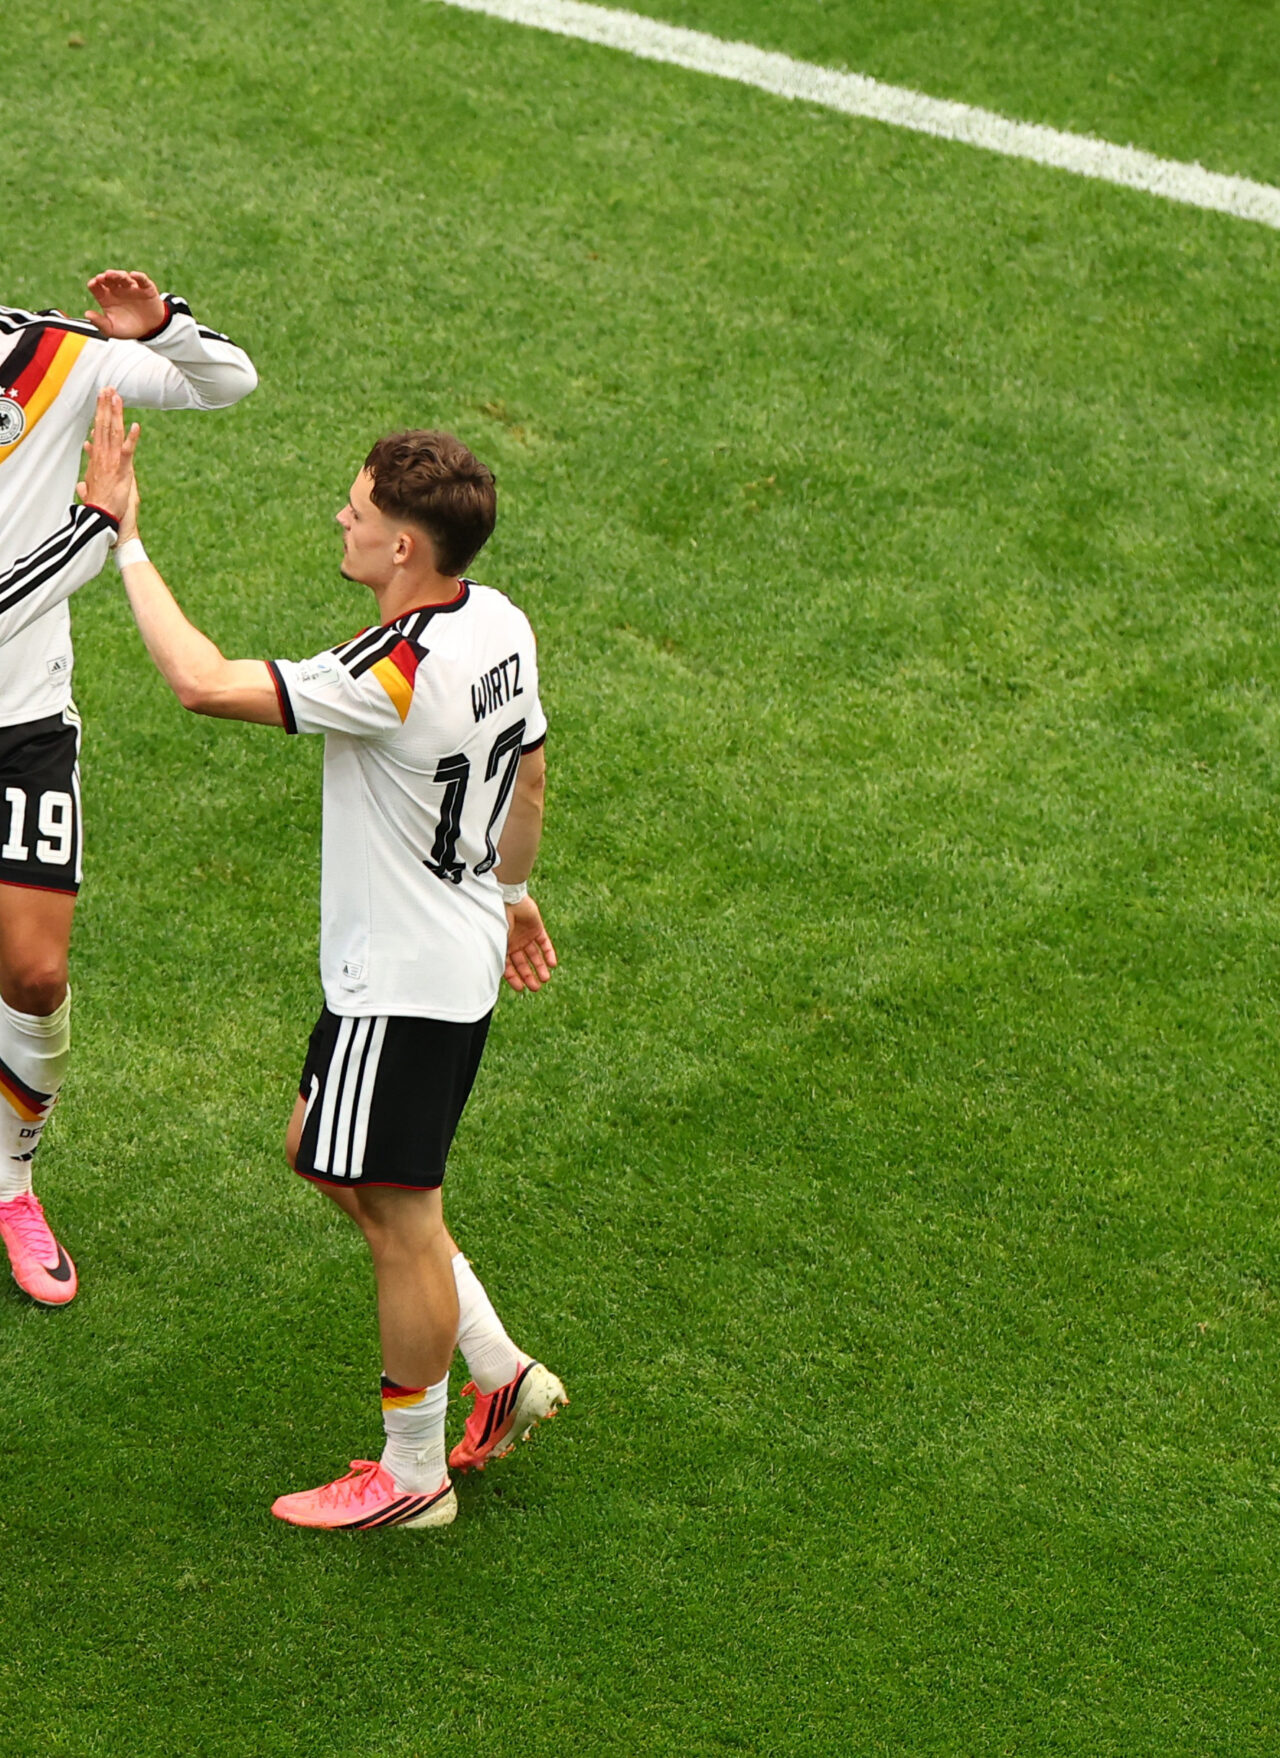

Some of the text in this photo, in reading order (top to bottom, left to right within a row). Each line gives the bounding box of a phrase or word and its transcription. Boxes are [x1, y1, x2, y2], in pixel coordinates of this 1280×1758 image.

[471, 652, 523, 723] WIRTZ
[2, 787, 73, 865] 19
[422, 717, 526, 884] 17
